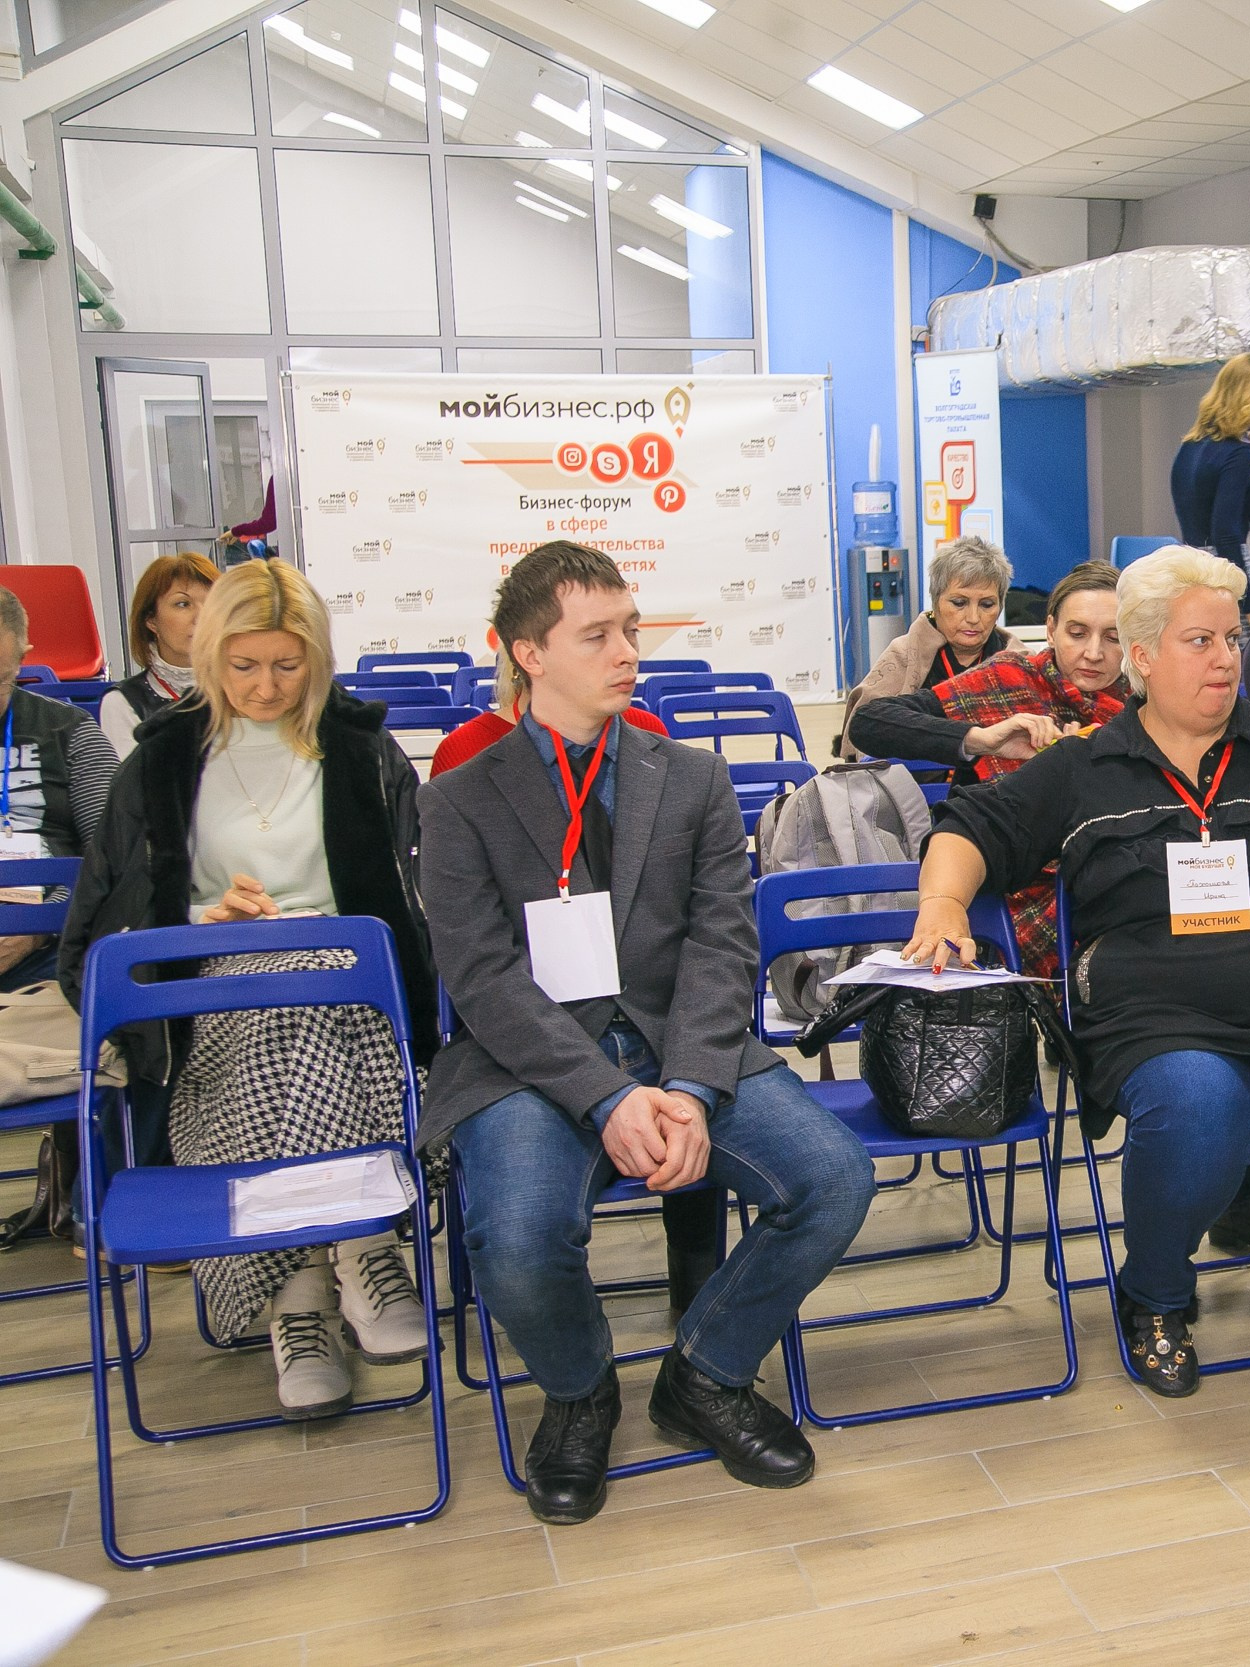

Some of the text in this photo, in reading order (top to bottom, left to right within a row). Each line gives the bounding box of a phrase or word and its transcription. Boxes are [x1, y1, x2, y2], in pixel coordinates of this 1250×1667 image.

[440, 393, 654, 424] мойбизнес.рф
[643, 442, 659, 474] Я
[519, 494, 632, 514] Бизнес-форум
[546, 517, 608, 534] в сфере
[1178, 857, 1224, 865] мойбизнес
[1182, 916, 1240, 928] УЧАСТНИК
